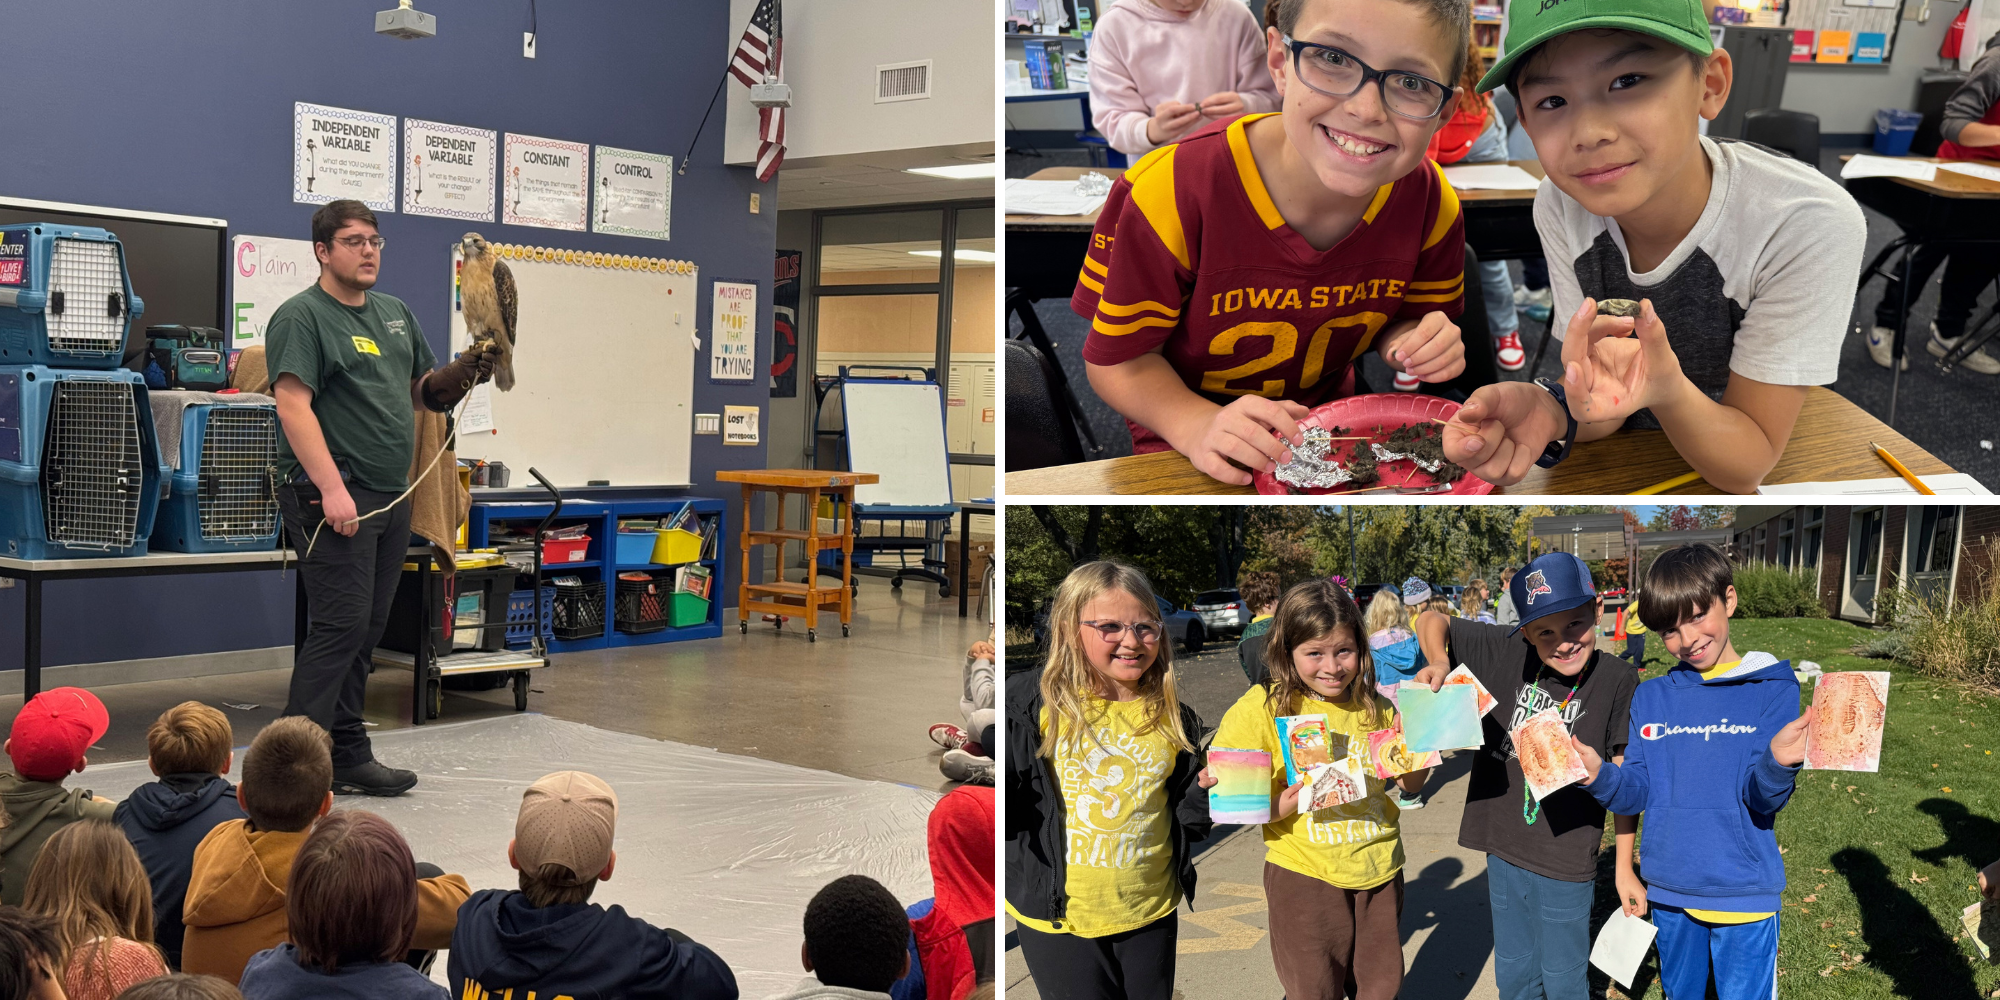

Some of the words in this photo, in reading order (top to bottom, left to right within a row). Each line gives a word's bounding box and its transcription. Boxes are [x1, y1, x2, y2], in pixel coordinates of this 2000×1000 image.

[312, 119, 380, 139] INDEPENDENT
[322, 135, 371, 152] VARIABLE
[425, 135, 476, 152] DEPENDENT
[428, 149, 473, 166] VARIABLE
[523, 150, 570, 168] CONSTANT
[614, 163, 653, 179] CONTROL
[0, 244, 24, 255] ENTER
[237, 241, 297, 277] Claim
[719, 287, 752, 300] MISTAKES
[1209, 287, 1302, 316] IOWA
[1310, 279, 1406, 309] STATE
[729, 302, 741, 312] ARE
[721, 313, 748, 330] PROOF
[727, 331, 742, 342] THAT
[721, 344, 733, 354] YOU
[735, 344, 747, 355] ARE
[1200, 311, 1388, 398] 20
[714, 356, 751, 376] TRYING
[727, 415, 744, 424] LOST
[1640, 718, 1757, 741] Champion
[1075, 744, 1137, 832] 3
[1066, 828, 1156, 870] RADE
